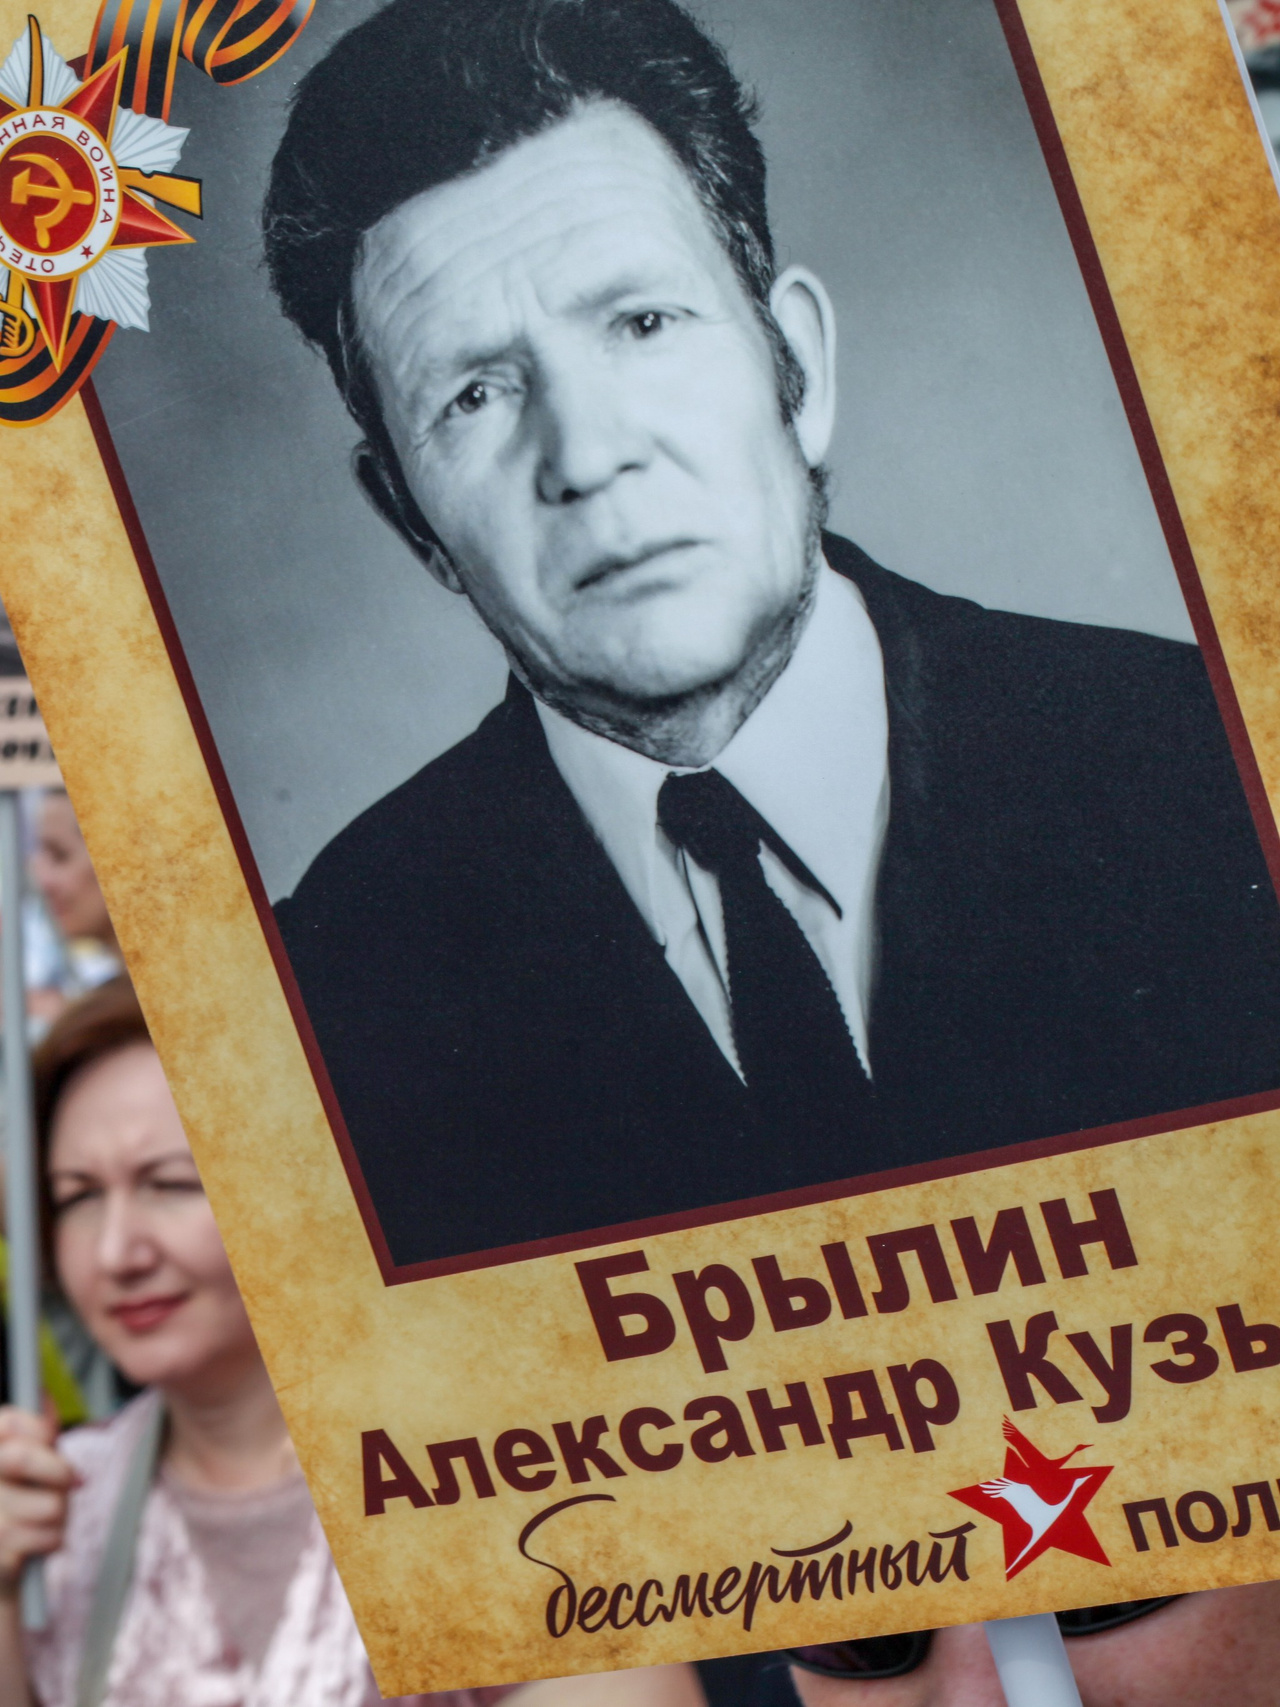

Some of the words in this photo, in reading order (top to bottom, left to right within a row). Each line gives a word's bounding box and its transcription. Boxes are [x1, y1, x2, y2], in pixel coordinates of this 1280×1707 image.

[75, 129, 116, 224] ВОЙНА
[574, 1187, 1138, 1374] Брылин
[360, 1358, 960, 1516] Александр
[986, 1303, 1280, 1423] Кузь
[518, 1494, 977, 1639] бессмертный
[1122, 1478, 1280, 1552] пол
